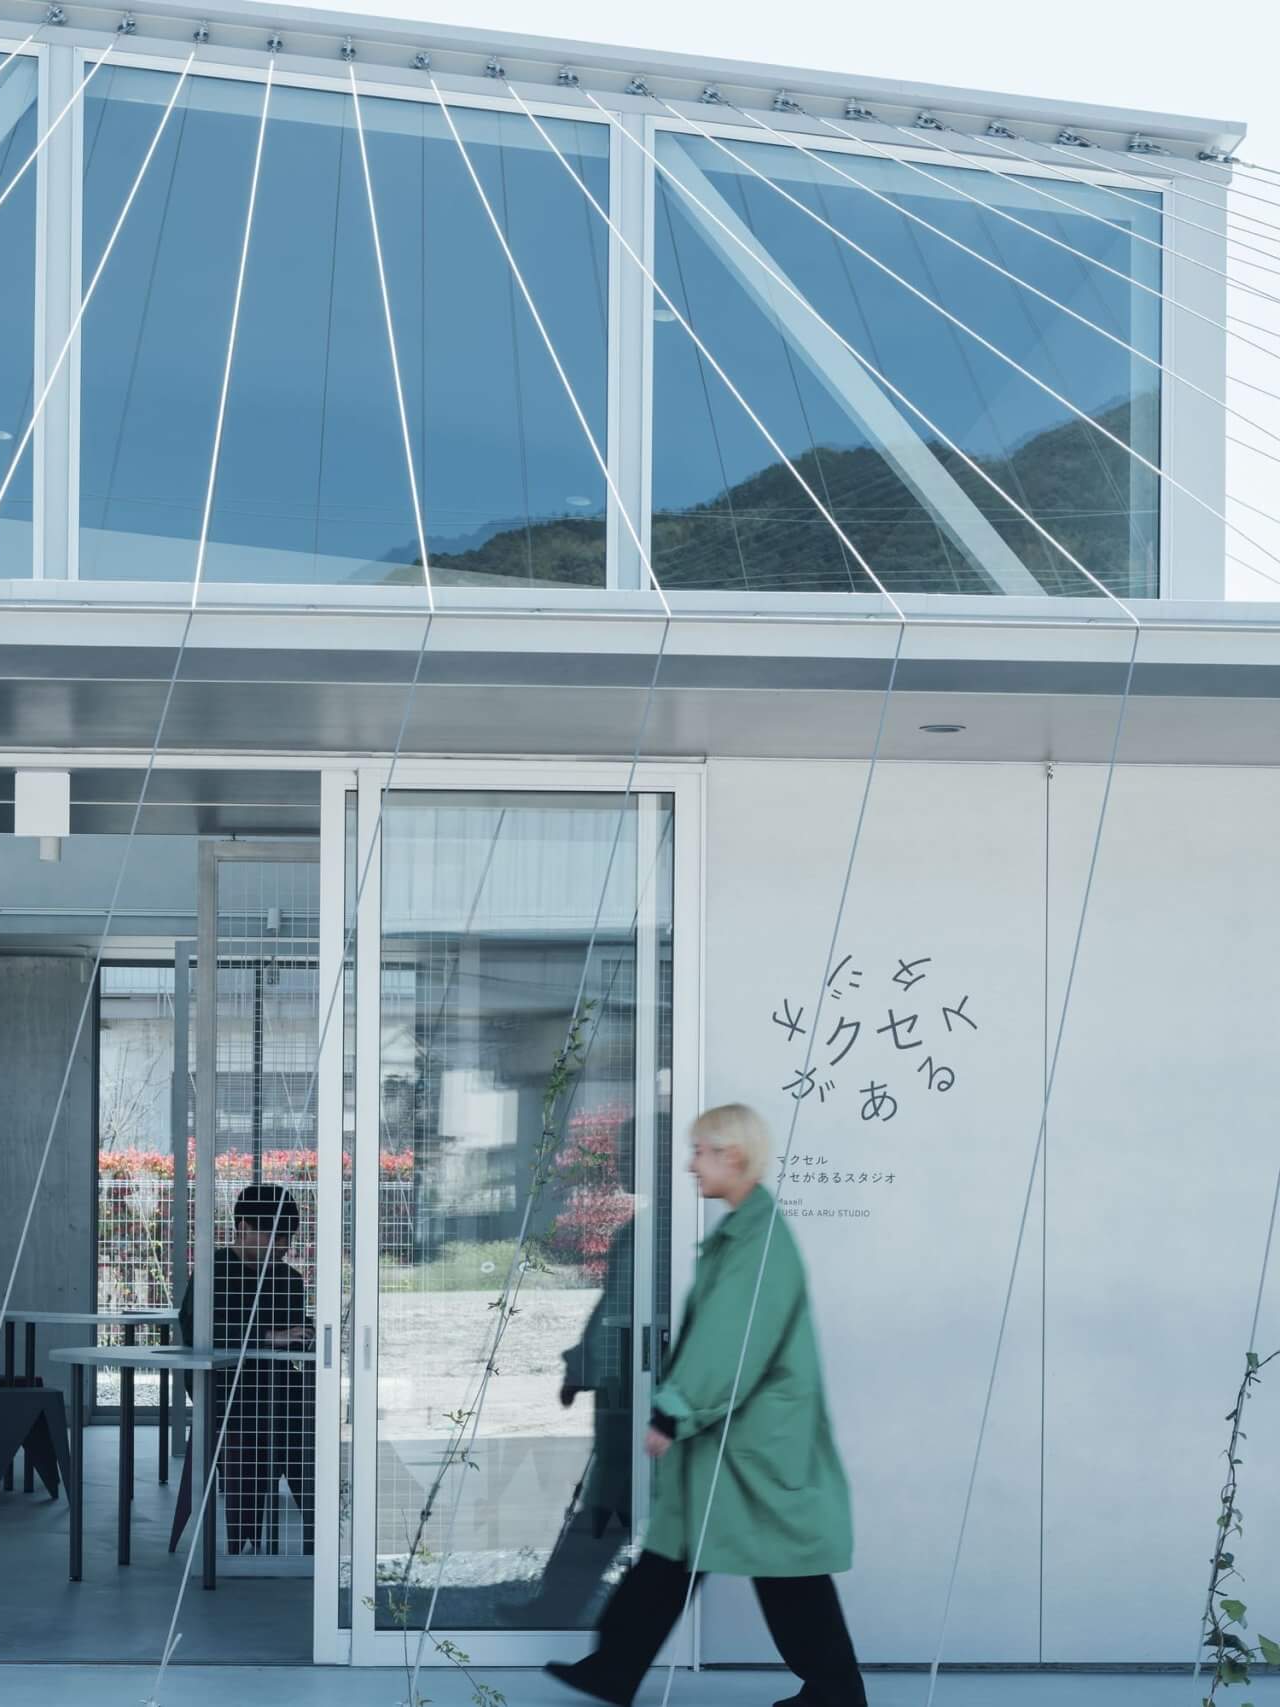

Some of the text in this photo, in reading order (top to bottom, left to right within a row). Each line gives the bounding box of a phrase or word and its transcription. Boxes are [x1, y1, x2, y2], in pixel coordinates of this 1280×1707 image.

[776, 1155, 828, 1166] マクセル
[776, 1172, 896, 1184] クセがあるスタジオ
[777, 1209, 871, 1218] USE GA ARU STUDIO
